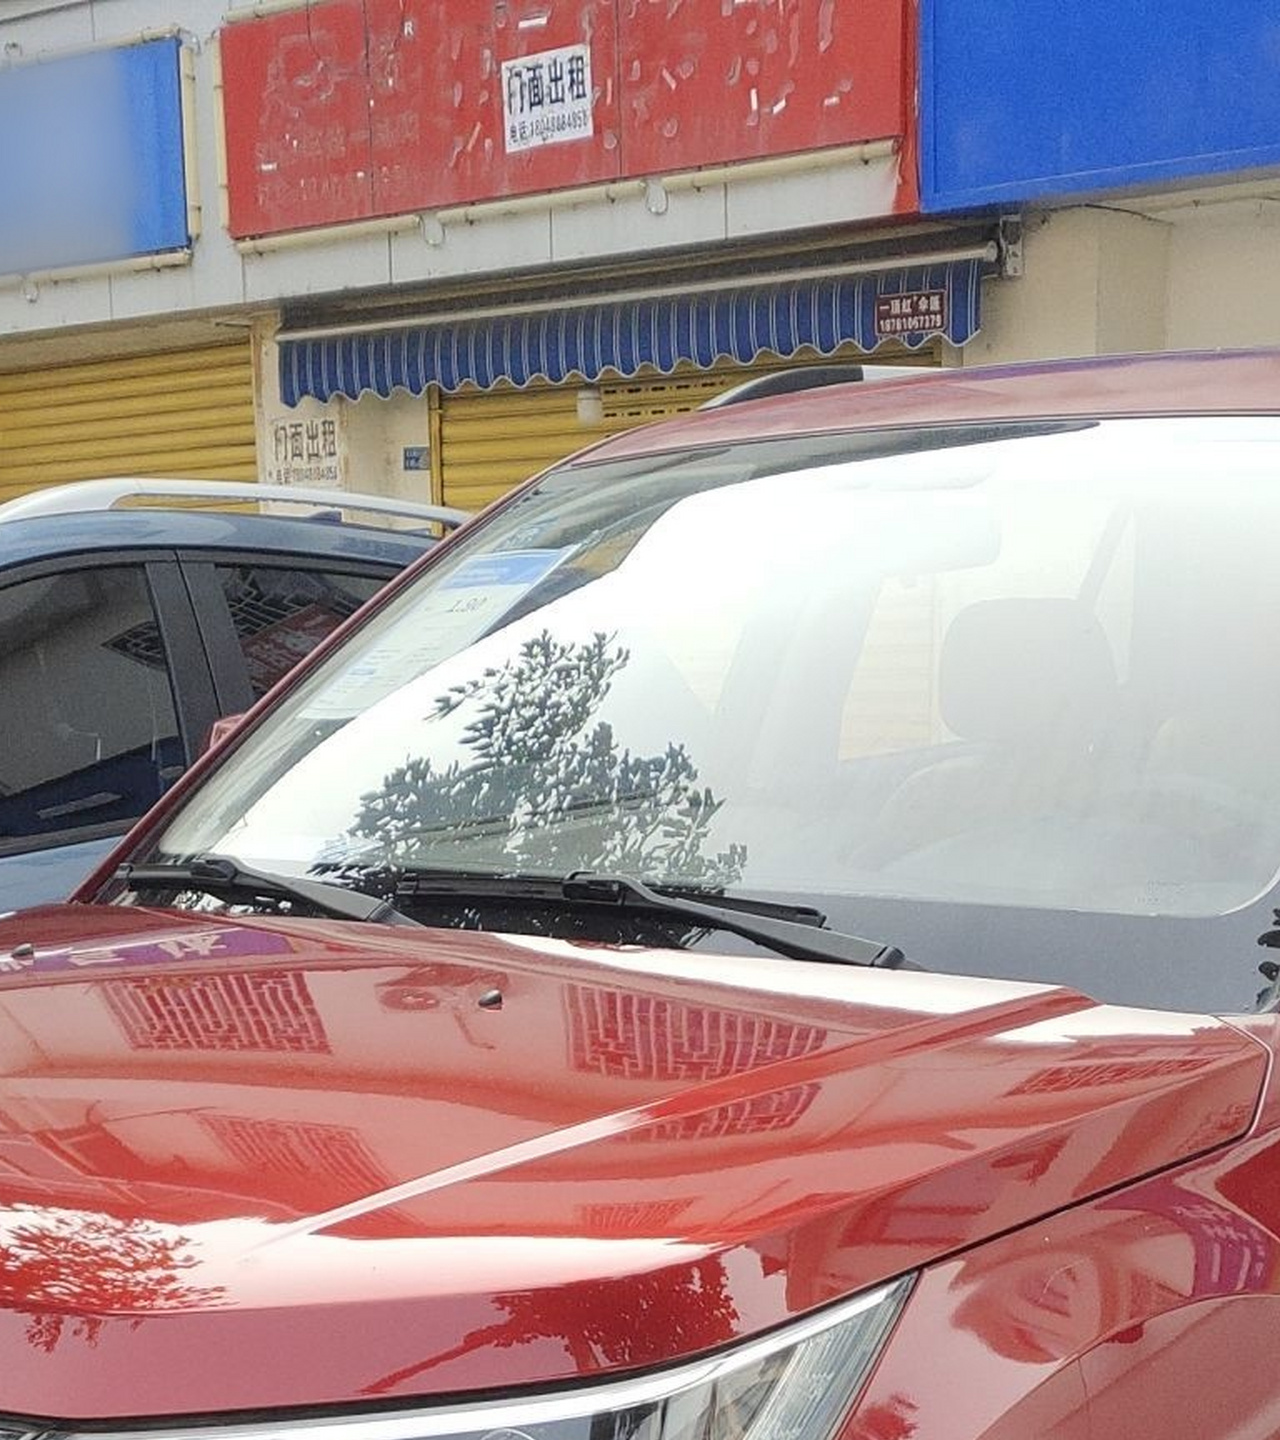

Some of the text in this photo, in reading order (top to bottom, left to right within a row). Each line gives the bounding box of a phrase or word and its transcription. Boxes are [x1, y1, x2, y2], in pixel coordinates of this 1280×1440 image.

[506, 55, 587, 115] 门面出租
[274, 420, 337, 463] 门面出租
